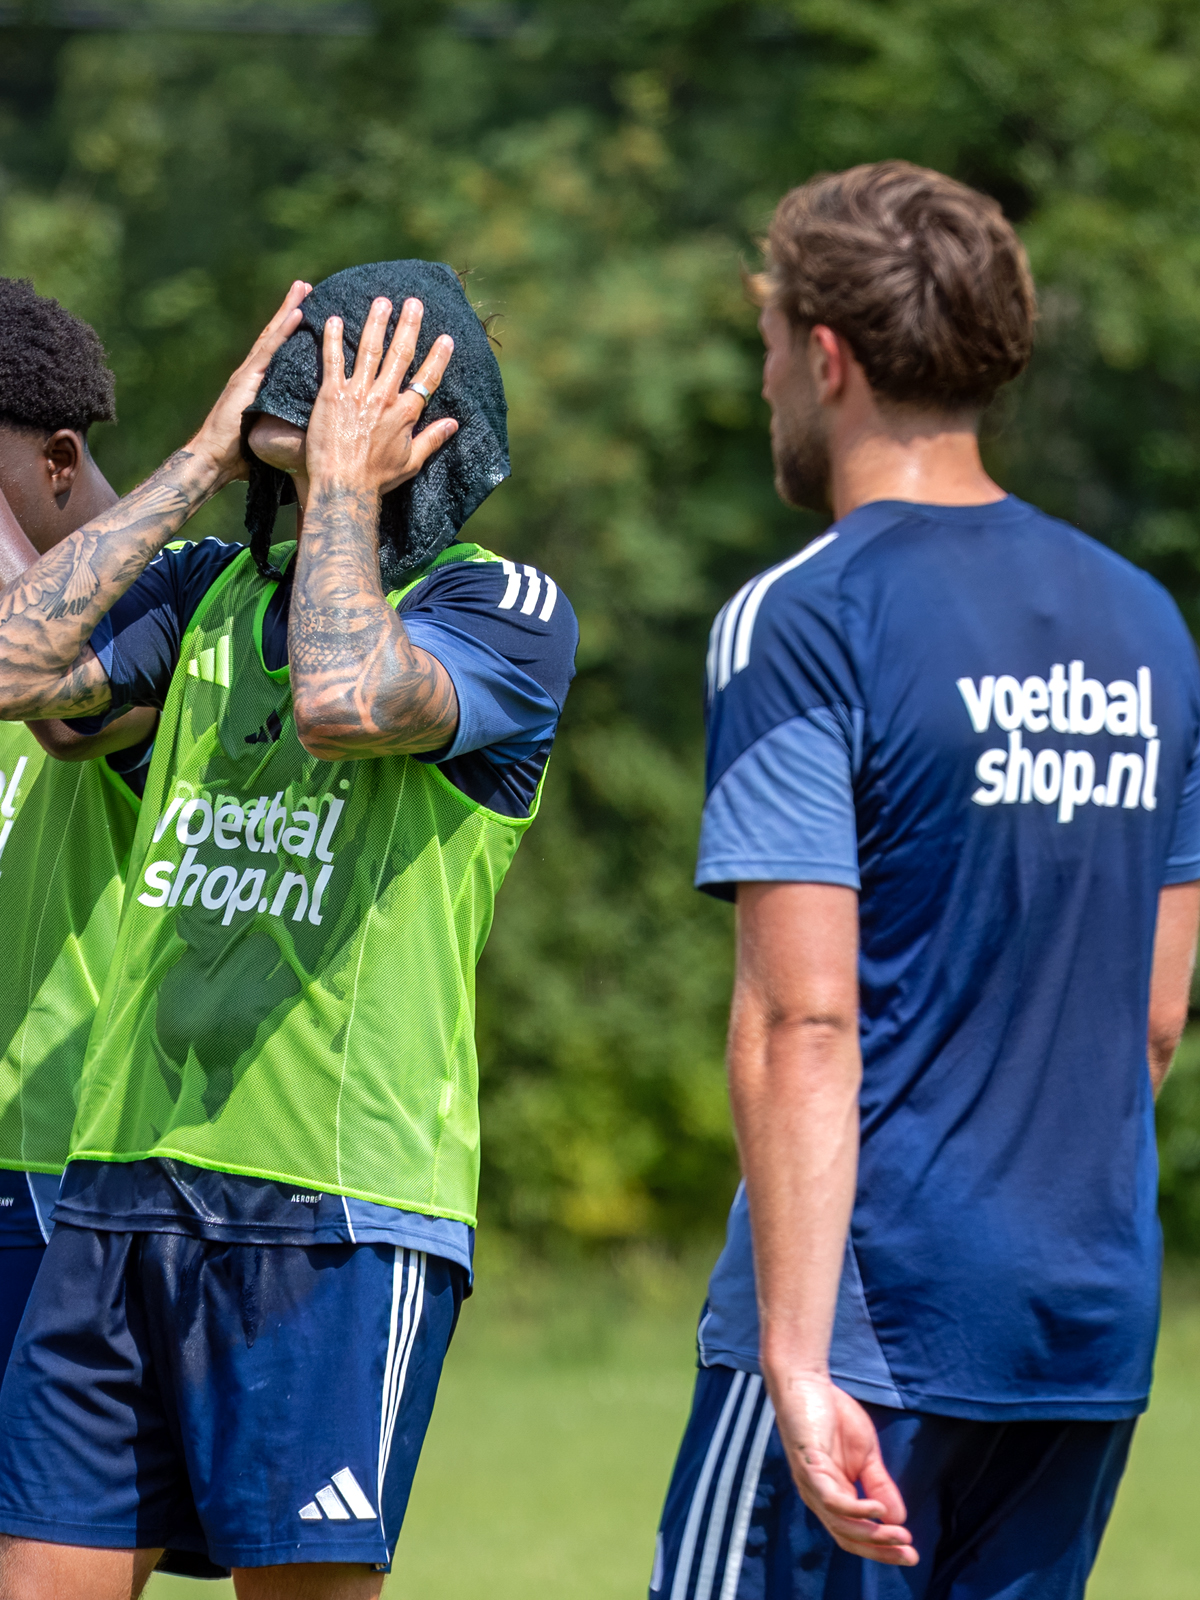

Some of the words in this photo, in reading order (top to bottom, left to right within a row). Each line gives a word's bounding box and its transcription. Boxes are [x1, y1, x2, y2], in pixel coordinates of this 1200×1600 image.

[956, 659, 1158, 739] voetbal
[971, 730, 1161, 823] shop.nl
[137, 847, 335, 926] shop.nl
